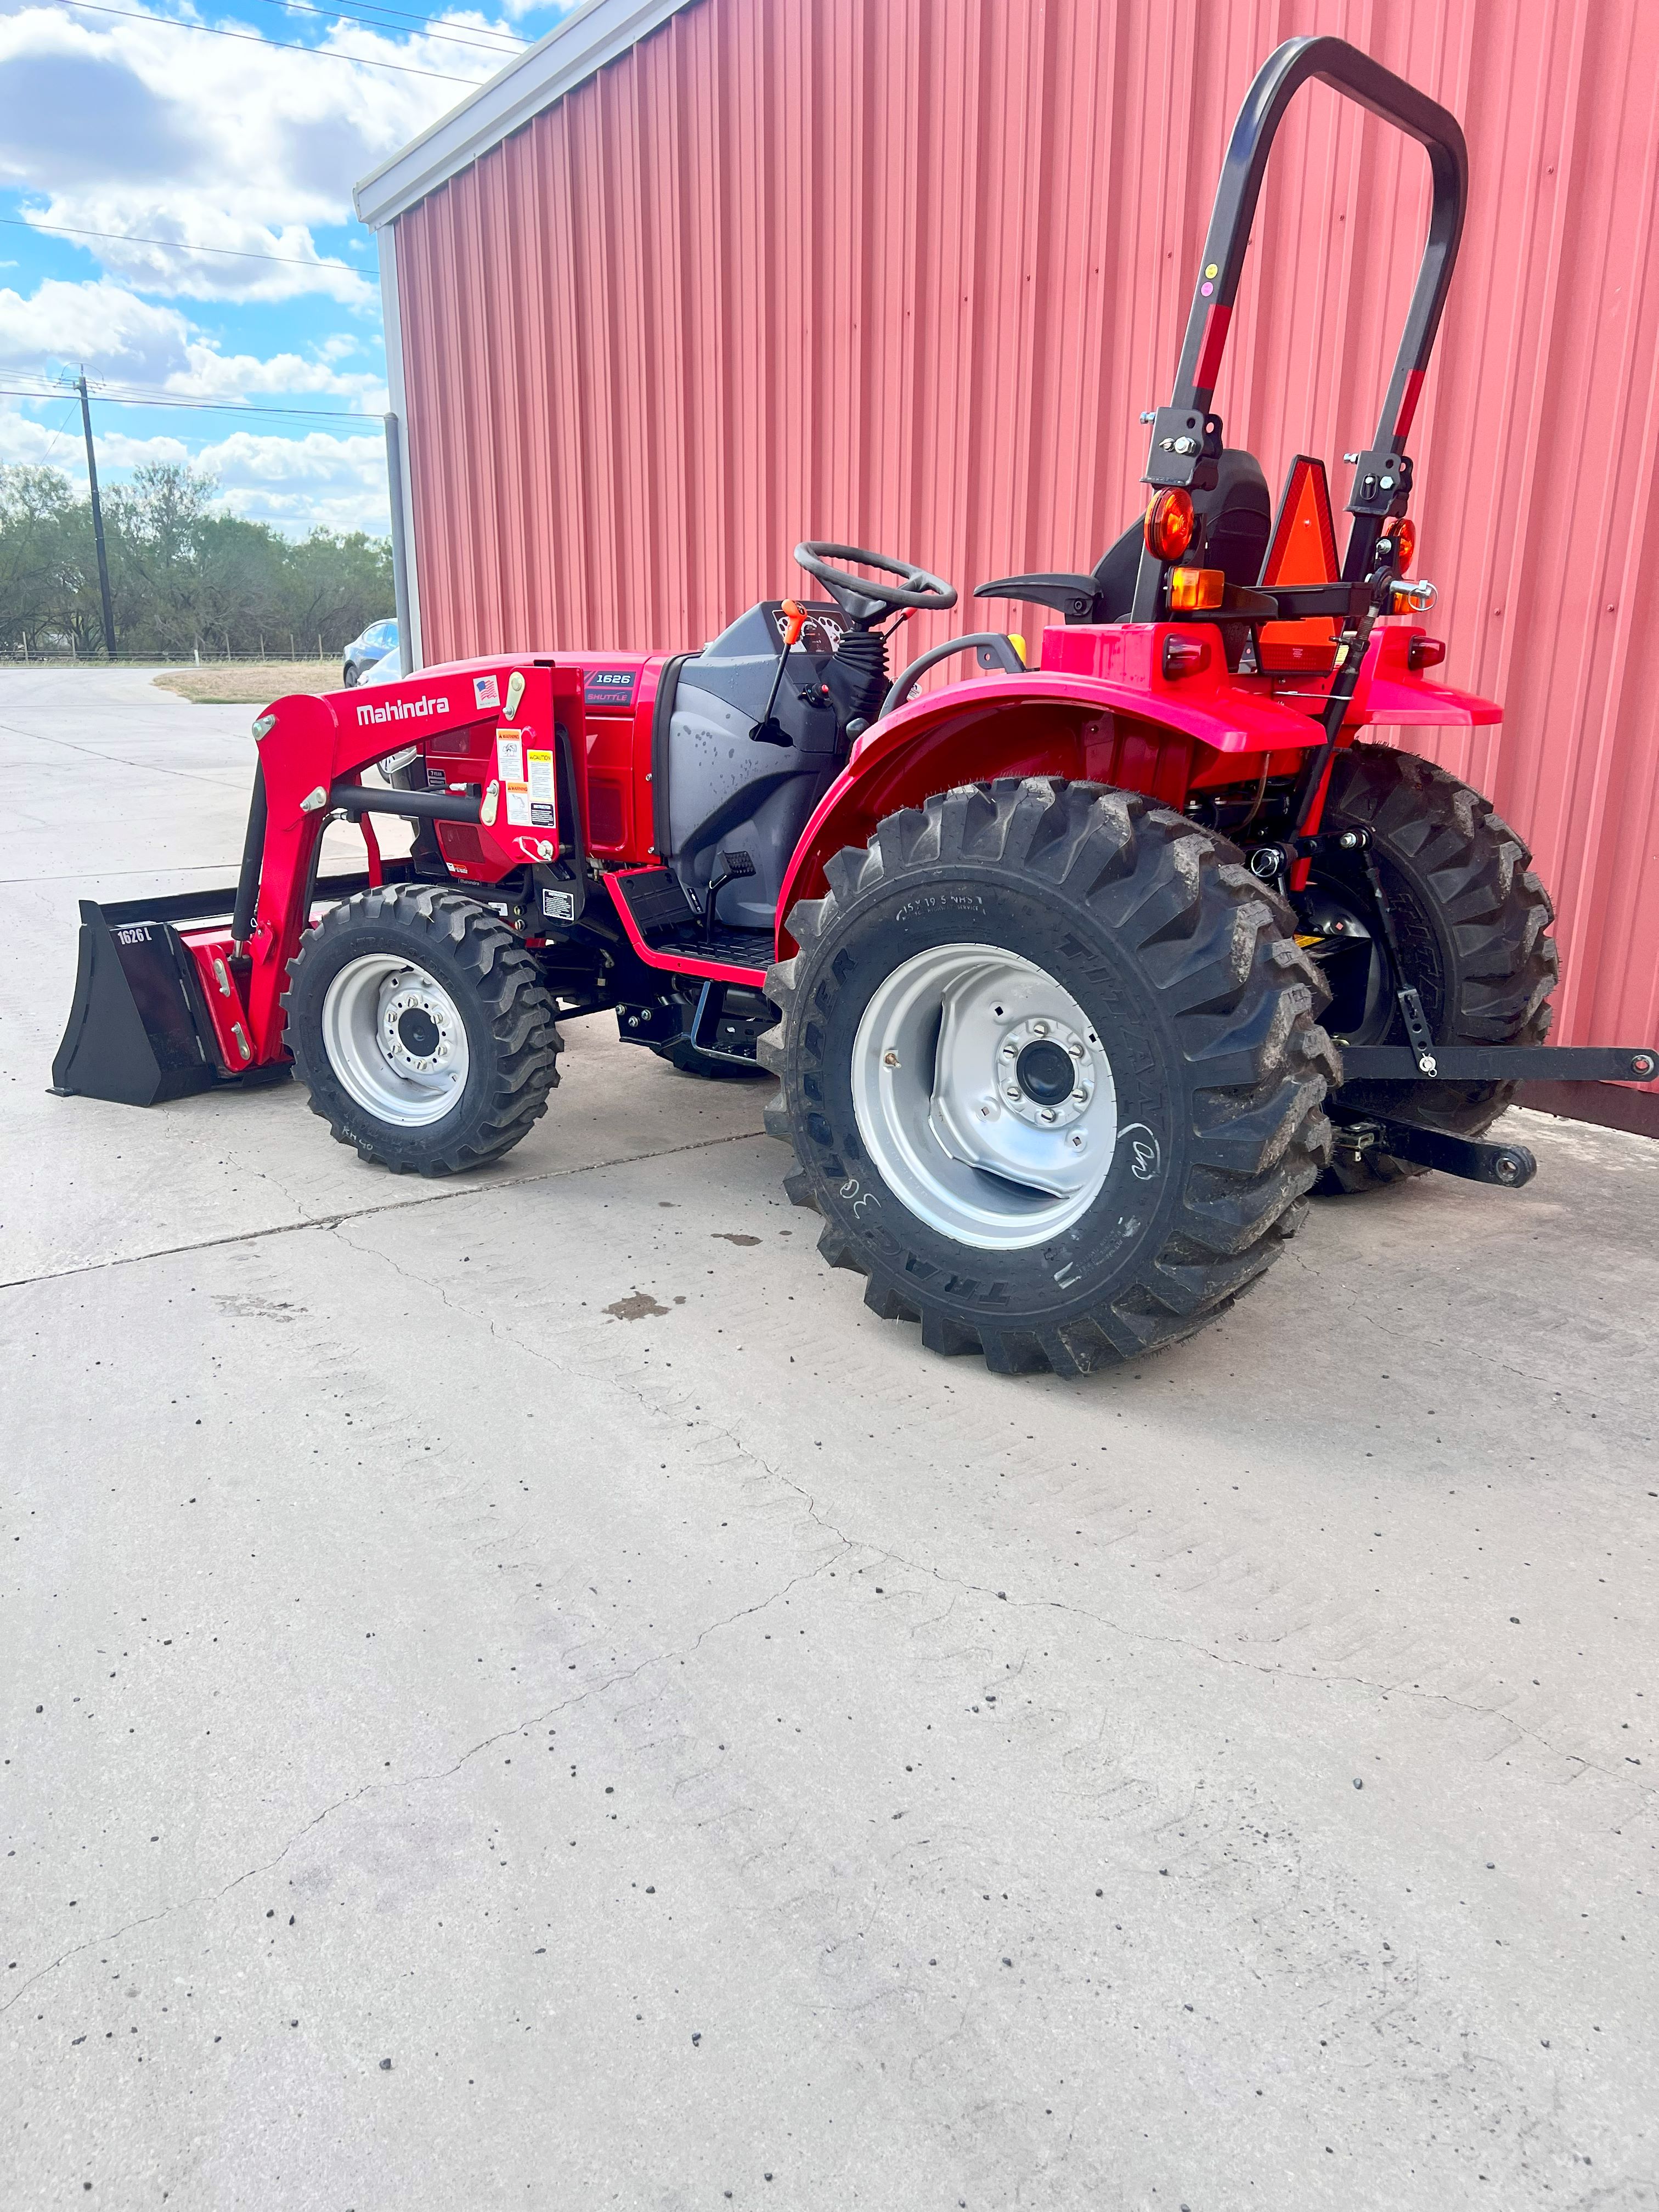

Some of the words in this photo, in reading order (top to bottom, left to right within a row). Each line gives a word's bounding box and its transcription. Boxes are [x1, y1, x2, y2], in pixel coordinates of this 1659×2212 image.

[596, 674, 631, 684] 1626
[588, 693, 628, 702] SHUTTLE
[356, 695, 450, 726] Mahindra
[117, 928, 144, 945] 1626
[144, 927, 153, 941] L
[803, 946, 859, 1181] LOADER
